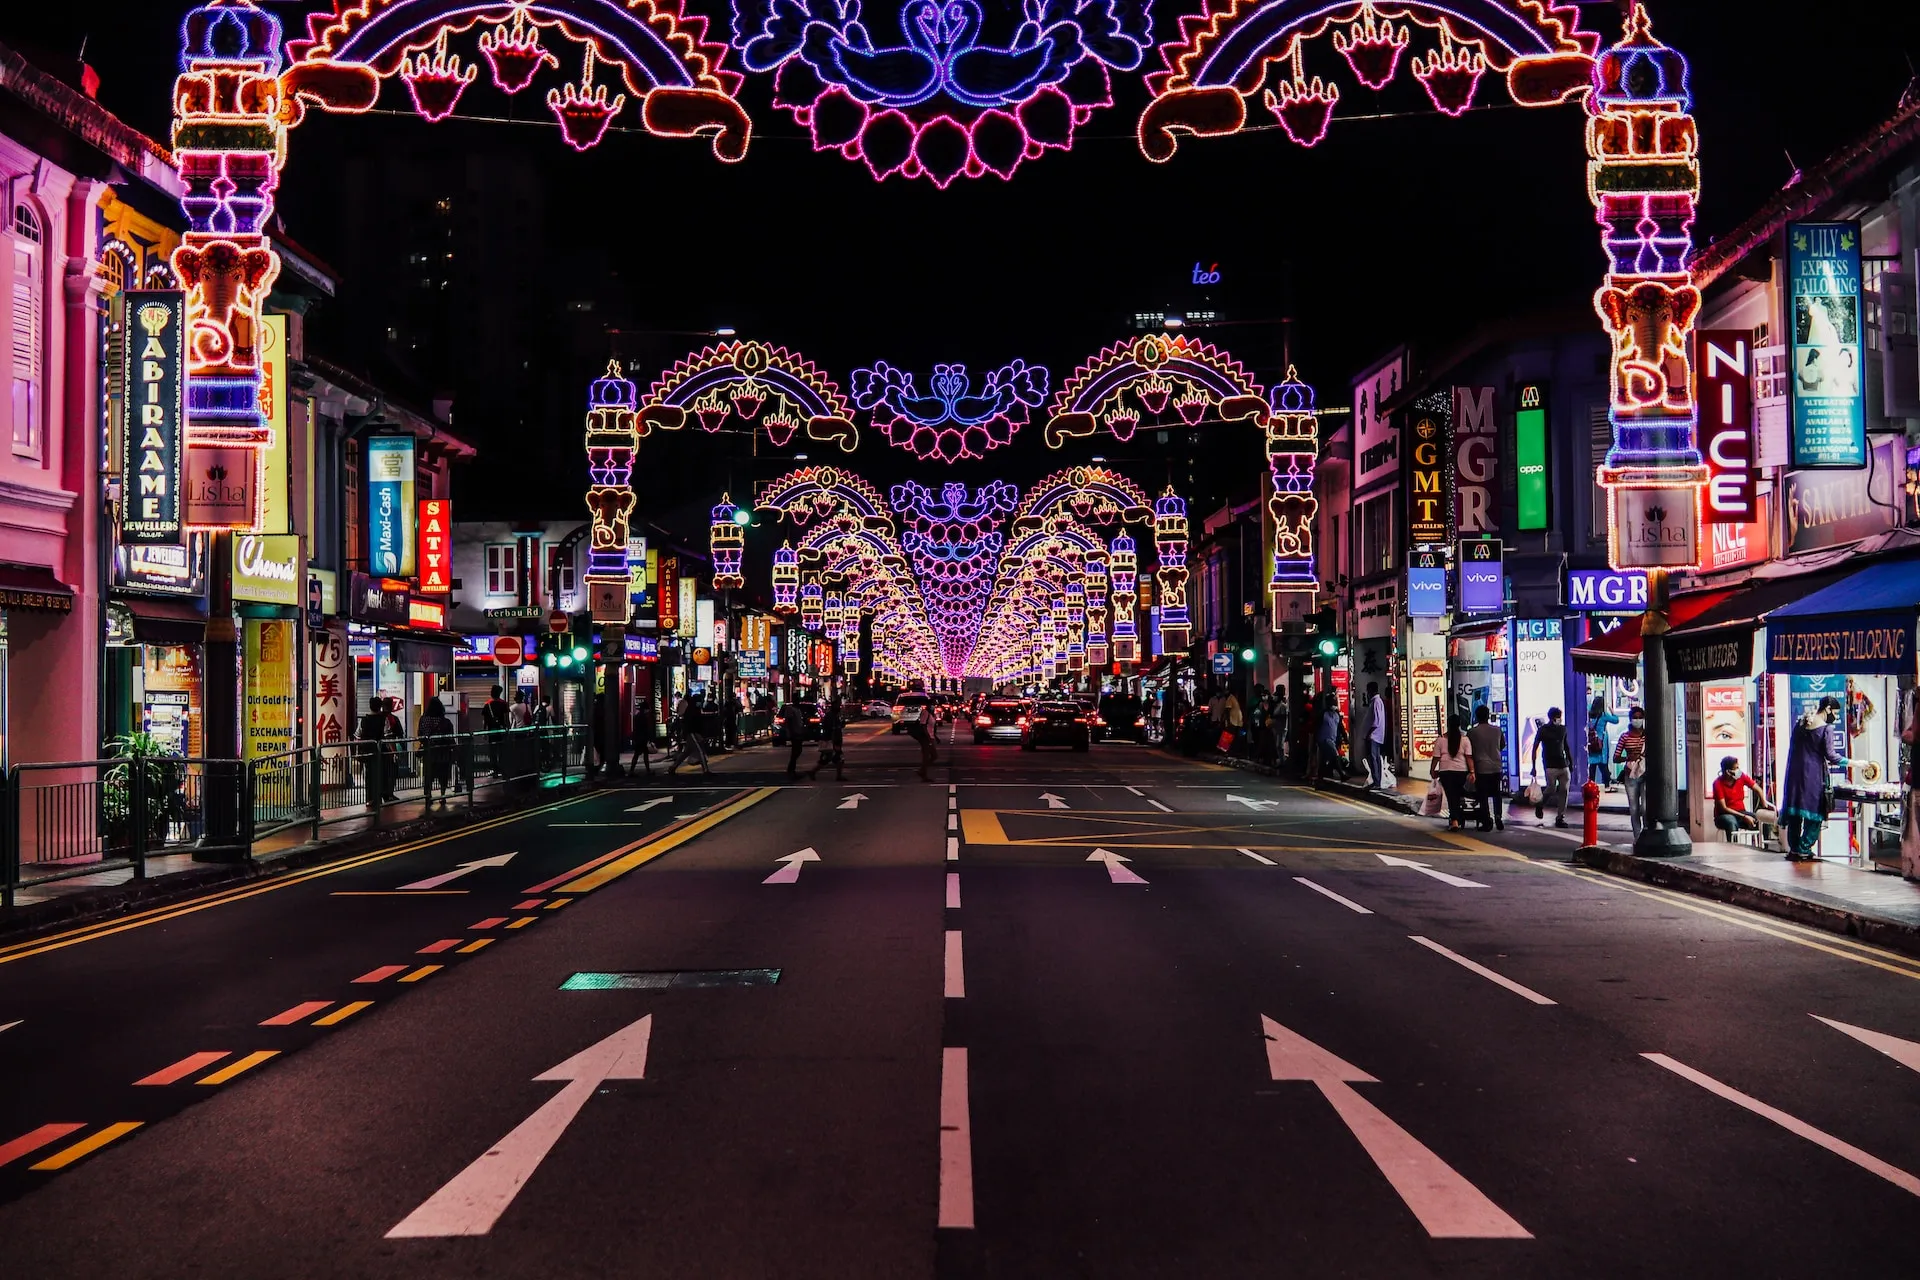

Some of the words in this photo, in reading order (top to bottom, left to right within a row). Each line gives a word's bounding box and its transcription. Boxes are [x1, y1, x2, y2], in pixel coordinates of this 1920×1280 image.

[1811, 229, 1838, 257] LILY
[140, 336, 166, 518] ABIRAAME
[1707, 340, 1747, 512] NICE
[1457, 387, 1499, 532] MGR
[1520, 465, 1543, 475] oppo
[188, 480, 245, 501] Lisha
[1413, 443, 1442, 521] GMT
[1803, 473, 1871, 528] SAKTHI
[123, 521, 179, 531] JEWELLERS
[379, 487, 391, 551] Maxi-Cash
[1627, 521, 1687, 542] Lisha
[426, 502, 441, 584] SATYA
[239, 535, 296, 581] Chennai
[1412, 581, 1442, 591] vivo
[1467, 573, 1498, 583] vivo
[1571, 575, 1647, 605] MGR
[487, 608, 523, 618] Kerbau
[526, 607, 539, 616] Rd
[1518, 621, 1560, 635] MGR
[1772, 634, 1795, 661] LILY
[1796, 632, 1841, 661] EXPRESS
[1842, 629, 1905, 660] TAILORING
[1520, 651, 1547, 660] OPPO
[1708, 642, 1739, 668] MOTORS
[1520, 664, 1537, 672] A94
[1415, 680, 1442, 694] 0%
[1458, 684, 1474, 695] 5G
[248, 696, 260, 704] Old
[263, 696, 280, 704] Gold
[1708, 691, 1742, 703] NICE
[250, 728, 292, 736] EXCHANGE
[256, 743, 287, 752] REPAIR
